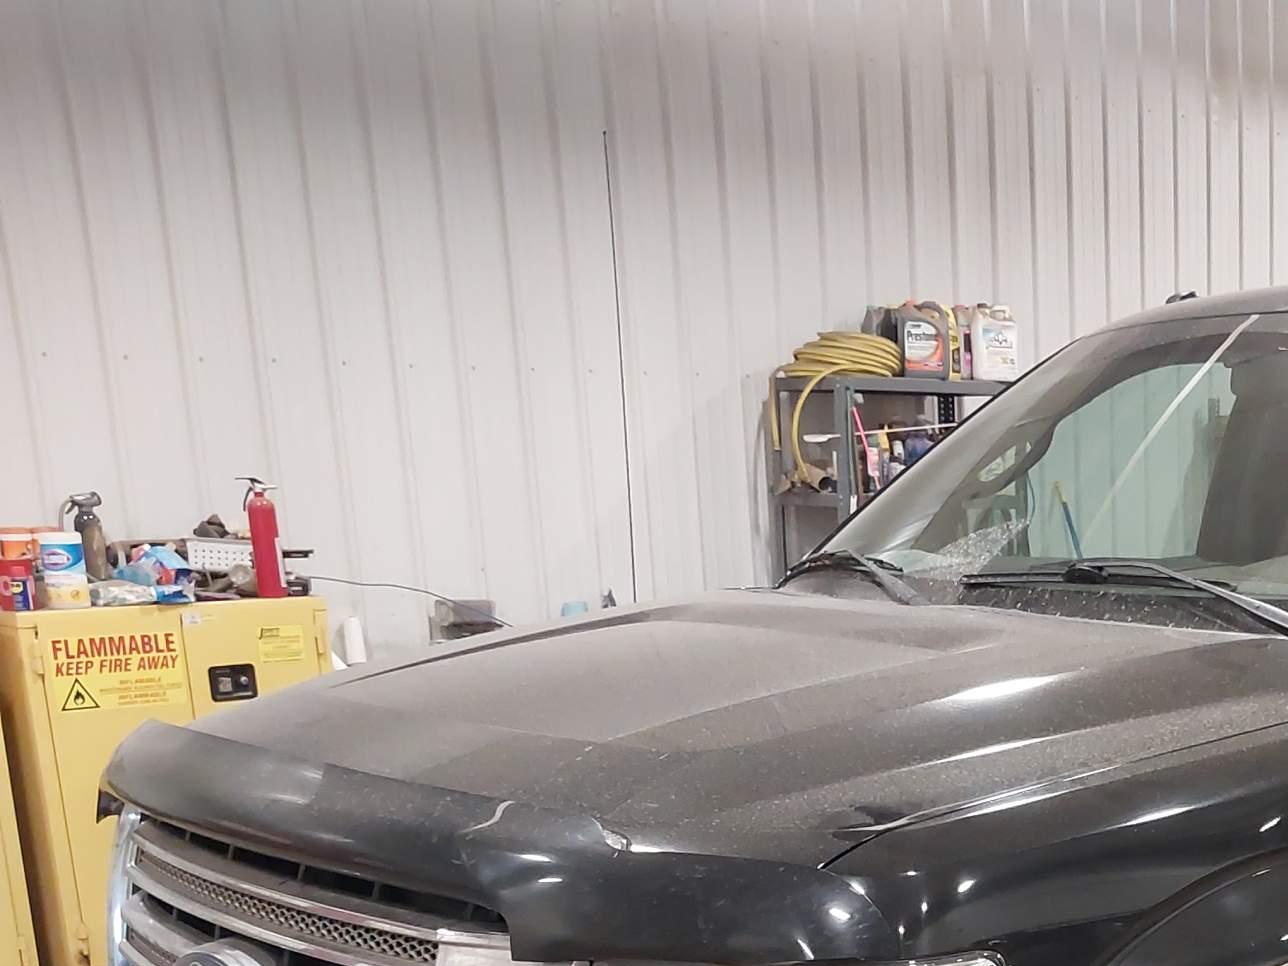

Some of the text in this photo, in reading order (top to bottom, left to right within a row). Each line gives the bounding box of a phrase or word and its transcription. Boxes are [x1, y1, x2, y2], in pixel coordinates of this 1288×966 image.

[907, 330, 937, 342] Prest
[51, 633, 176, 660] FLAMMABLE
[55, 654, 178, 677] KEEP FIRE AWAY
